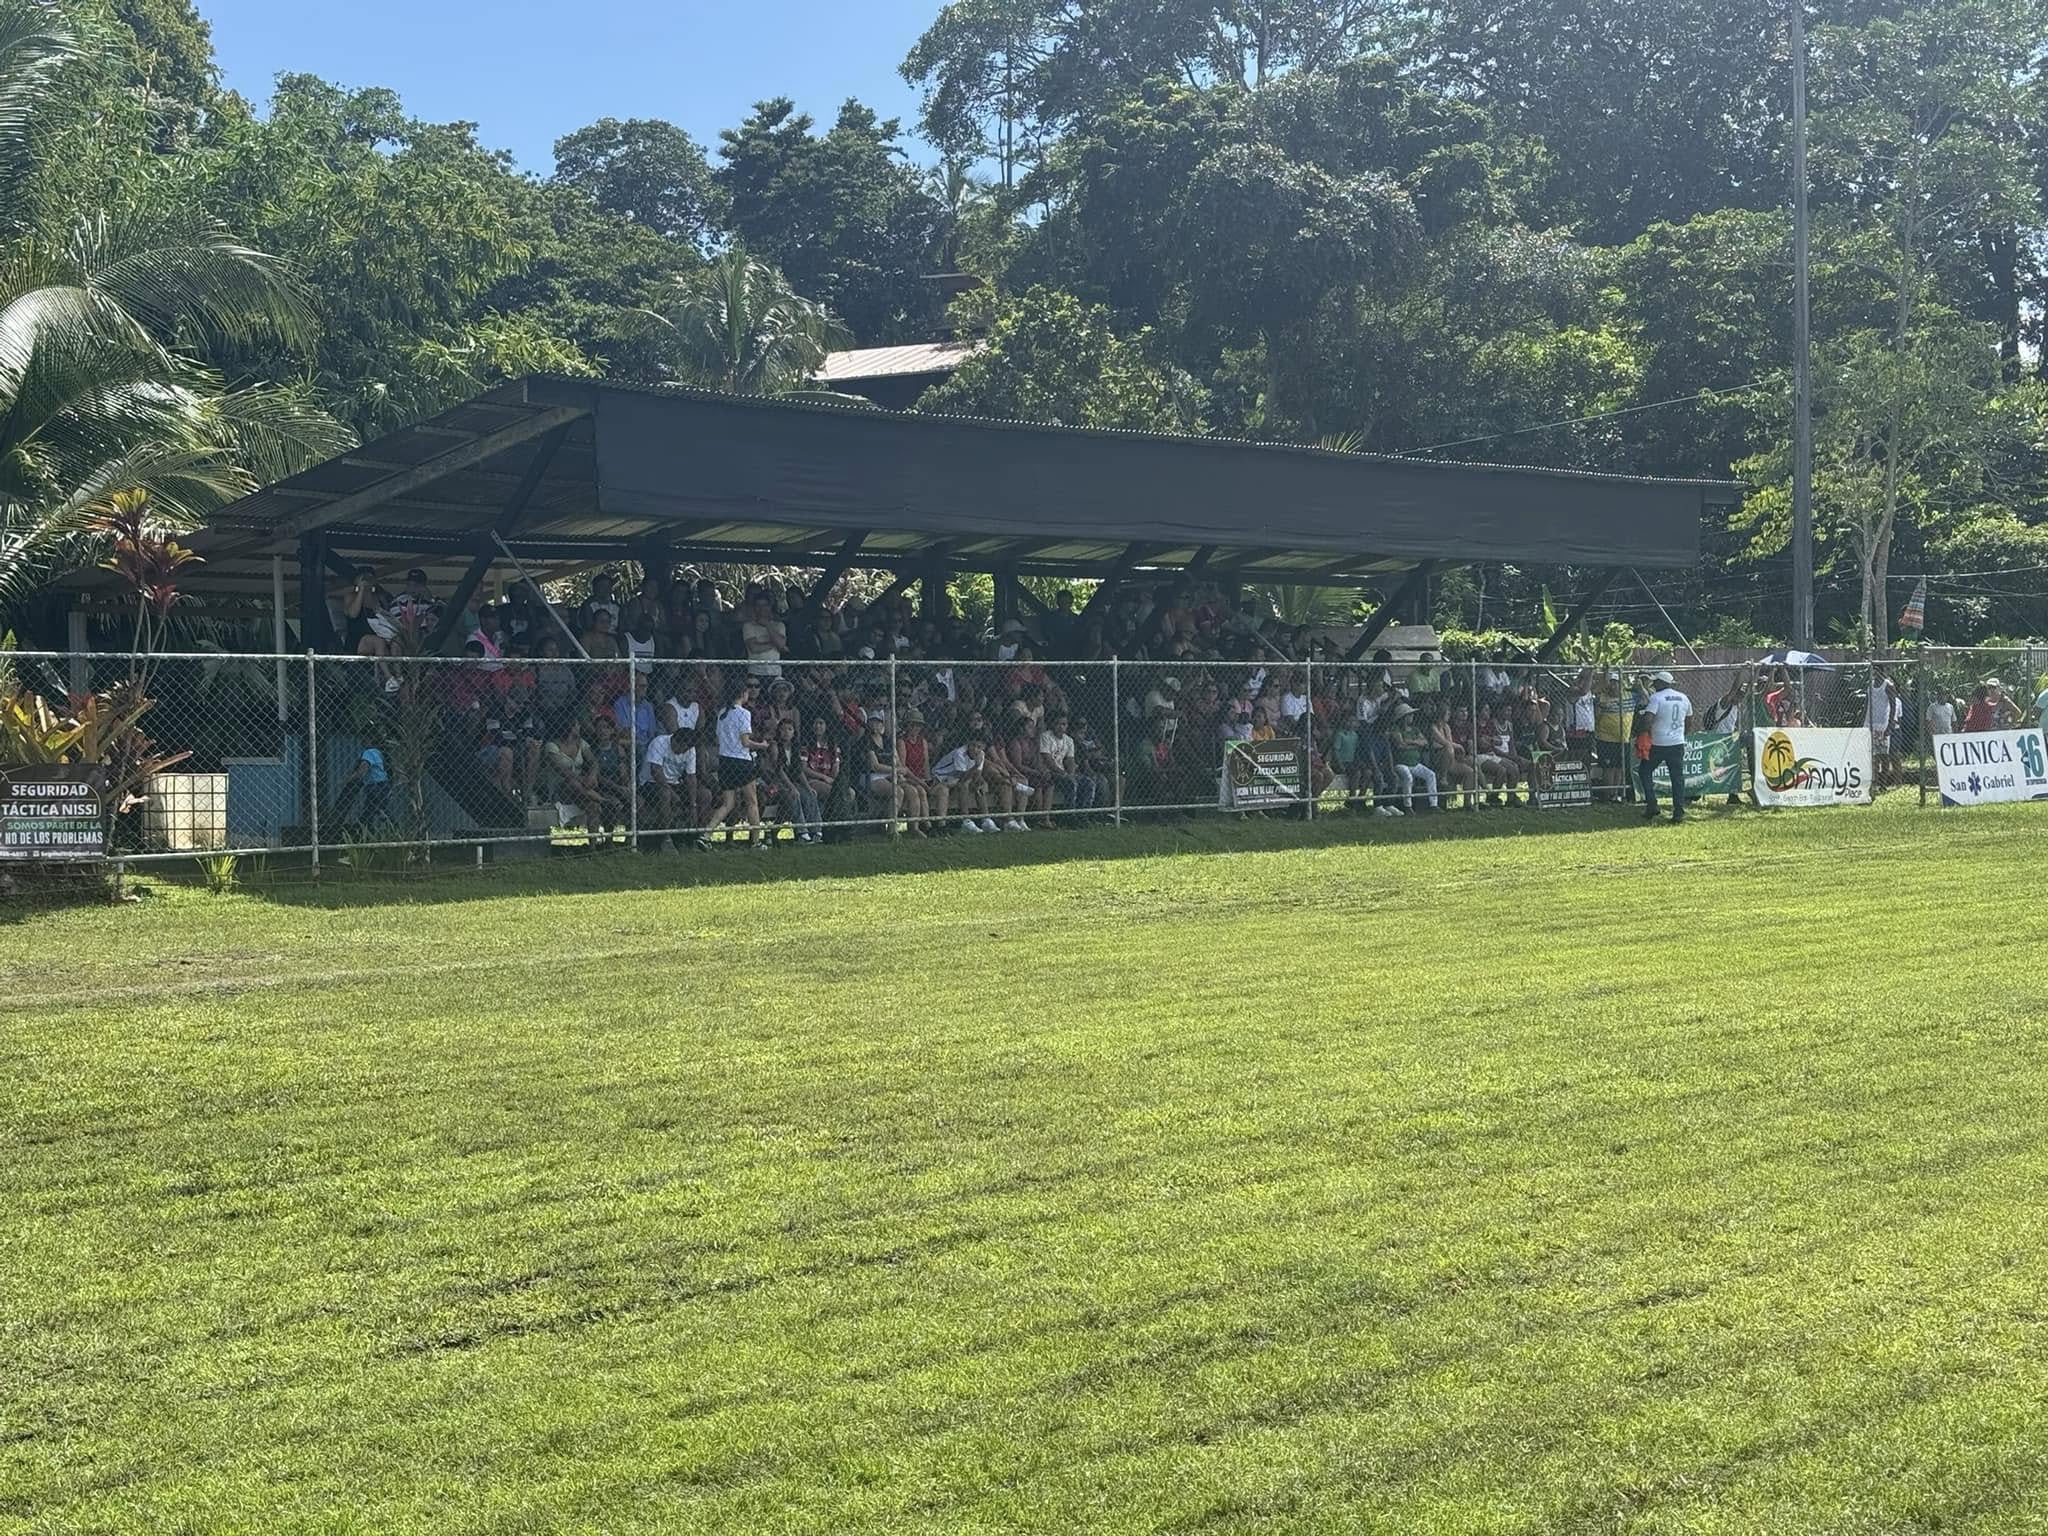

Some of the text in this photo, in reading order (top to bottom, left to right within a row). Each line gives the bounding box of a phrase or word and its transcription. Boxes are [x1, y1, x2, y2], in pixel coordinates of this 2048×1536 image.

[1257, 753, 1294, 763] SEGURIDAD
[1940, 739, 2013, 767] CLINICA
[2016, 734, 2044, 778] 16
[1691, 763, 1703, 774] DE
[1950, 778, 1967, 792] San
[1982, 774, 2015, 790] Gabriel
[11, 784, 88, 797] SEGURIDAD
[1, 801, 97, 816] TÁCTICA NISSI
[7, 821, 102, 830] SOMOS PARTE DE LA
[5, 832, 17, 845] NO
[20, 832, 31, 845] DE
[34, 832, 50, 845] LOS
[52, 831, 103, 844] PROBLEMAS
